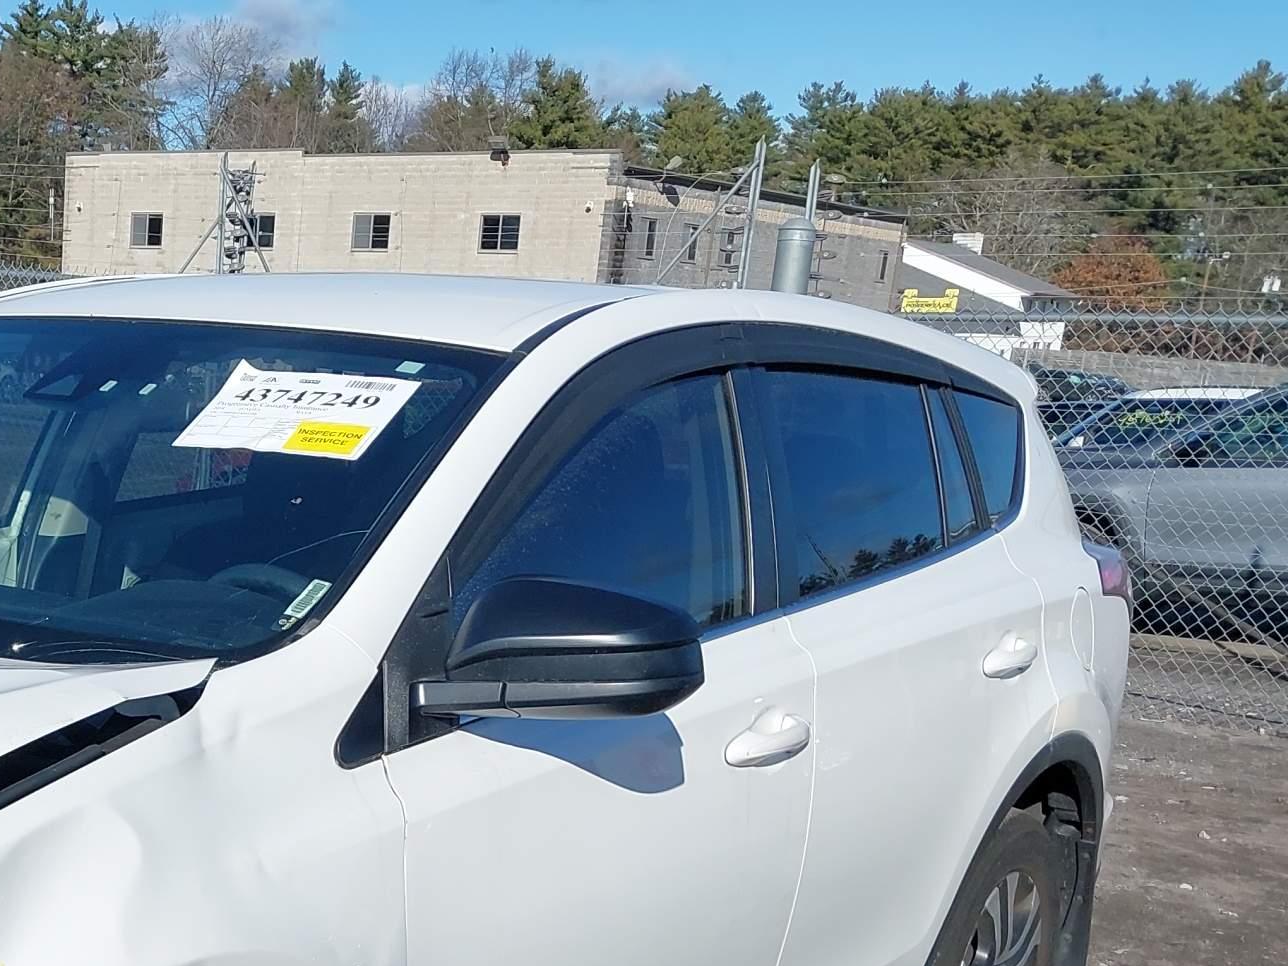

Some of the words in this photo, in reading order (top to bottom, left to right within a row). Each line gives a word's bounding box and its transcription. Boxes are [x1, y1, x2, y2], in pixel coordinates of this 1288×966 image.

[235, 387, 381, 409] 43747249
[298, 428, 364, 440] INSPECTION
[300, 436, 349, 446] SERVICE
